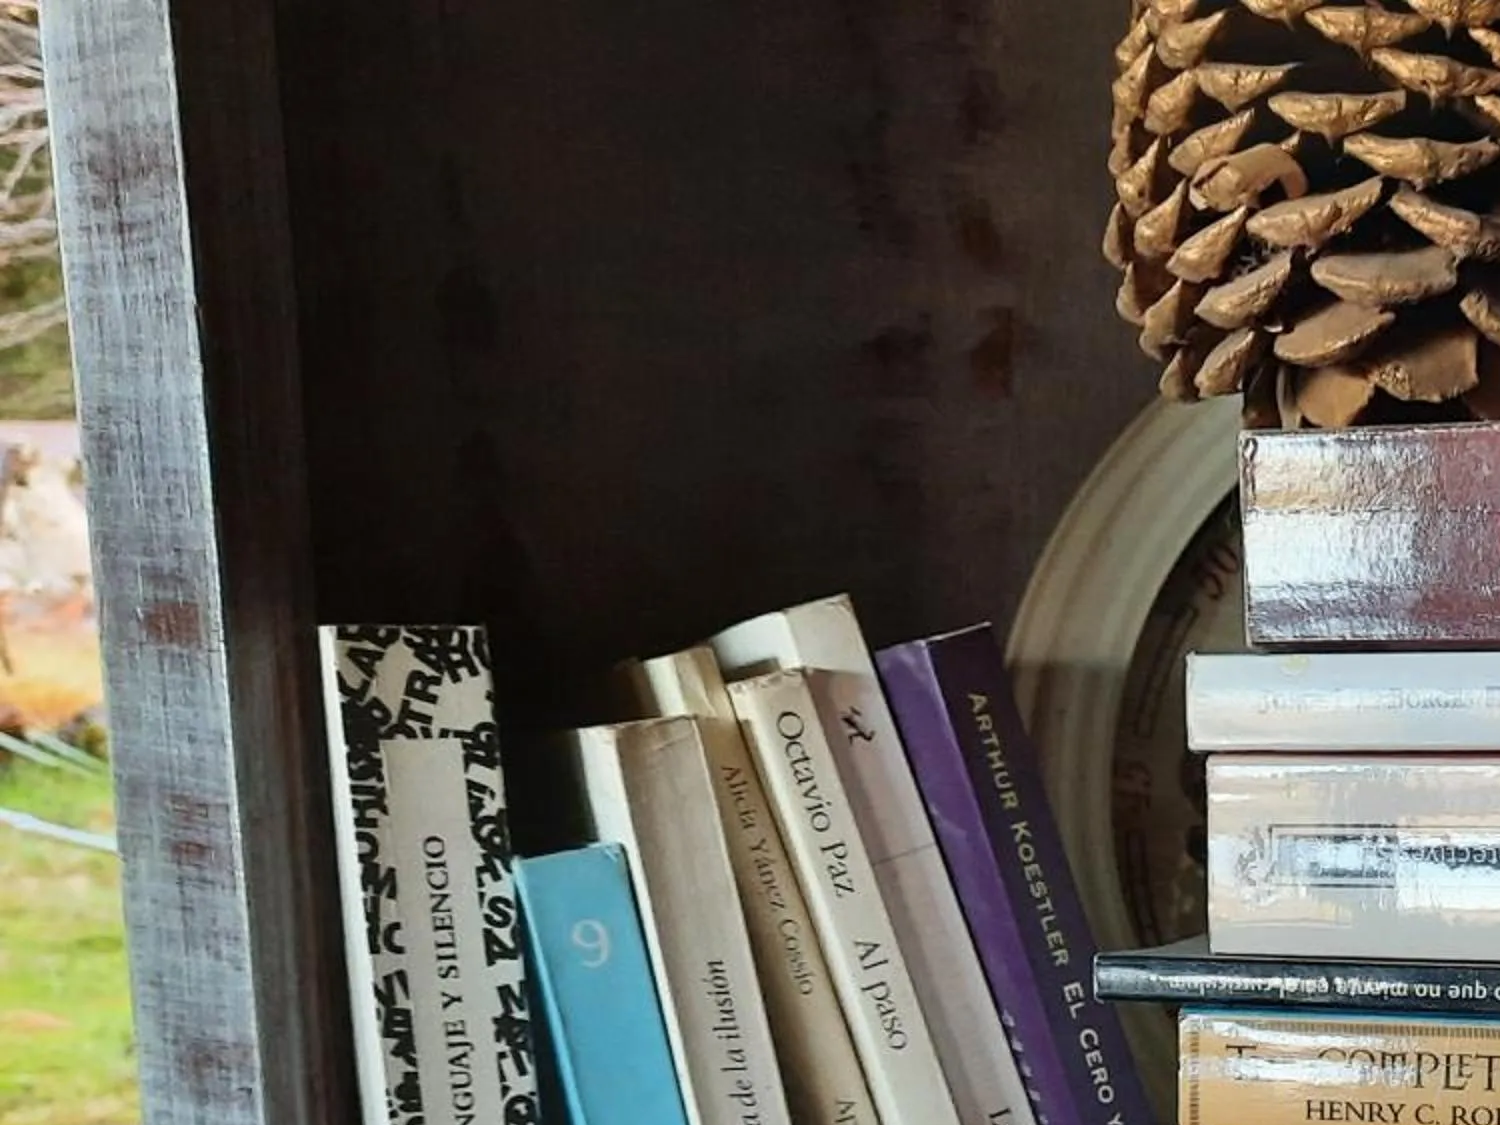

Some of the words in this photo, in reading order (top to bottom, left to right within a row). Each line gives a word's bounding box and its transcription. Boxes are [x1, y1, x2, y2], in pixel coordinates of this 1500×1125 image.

[721, 765, 758, 830] Alicia
[775, 710, 832, 833] Octavio
[820, 842, 856, 899] Paz
[424, 834, 462, 980] SILENCIO
[969, 694, 1017, 809] ARTHUR
[1012, 822, 1068, 967] KOESTLER
[1064, 983, 1092, 1020] EL
[1080, 1027, 1116, 1105] CERO
[571, 918, 612, 970] 9
[853, 937, 882, 972] Al
[442, 991, 463, 1012] Y
[703, 958, 740, 1047] ilusión
[1412, 981, 1443, 999] no
[1449, 980, 1489, 1001] que
[861, 980, 909, 1051] paso
[720, 1047, 749, 1076] la
[731, 1079, 756, 1112] de
[1305, 1097, 1406, 1124] HENRY
[1415, 1102, 1442, 1125] C.
